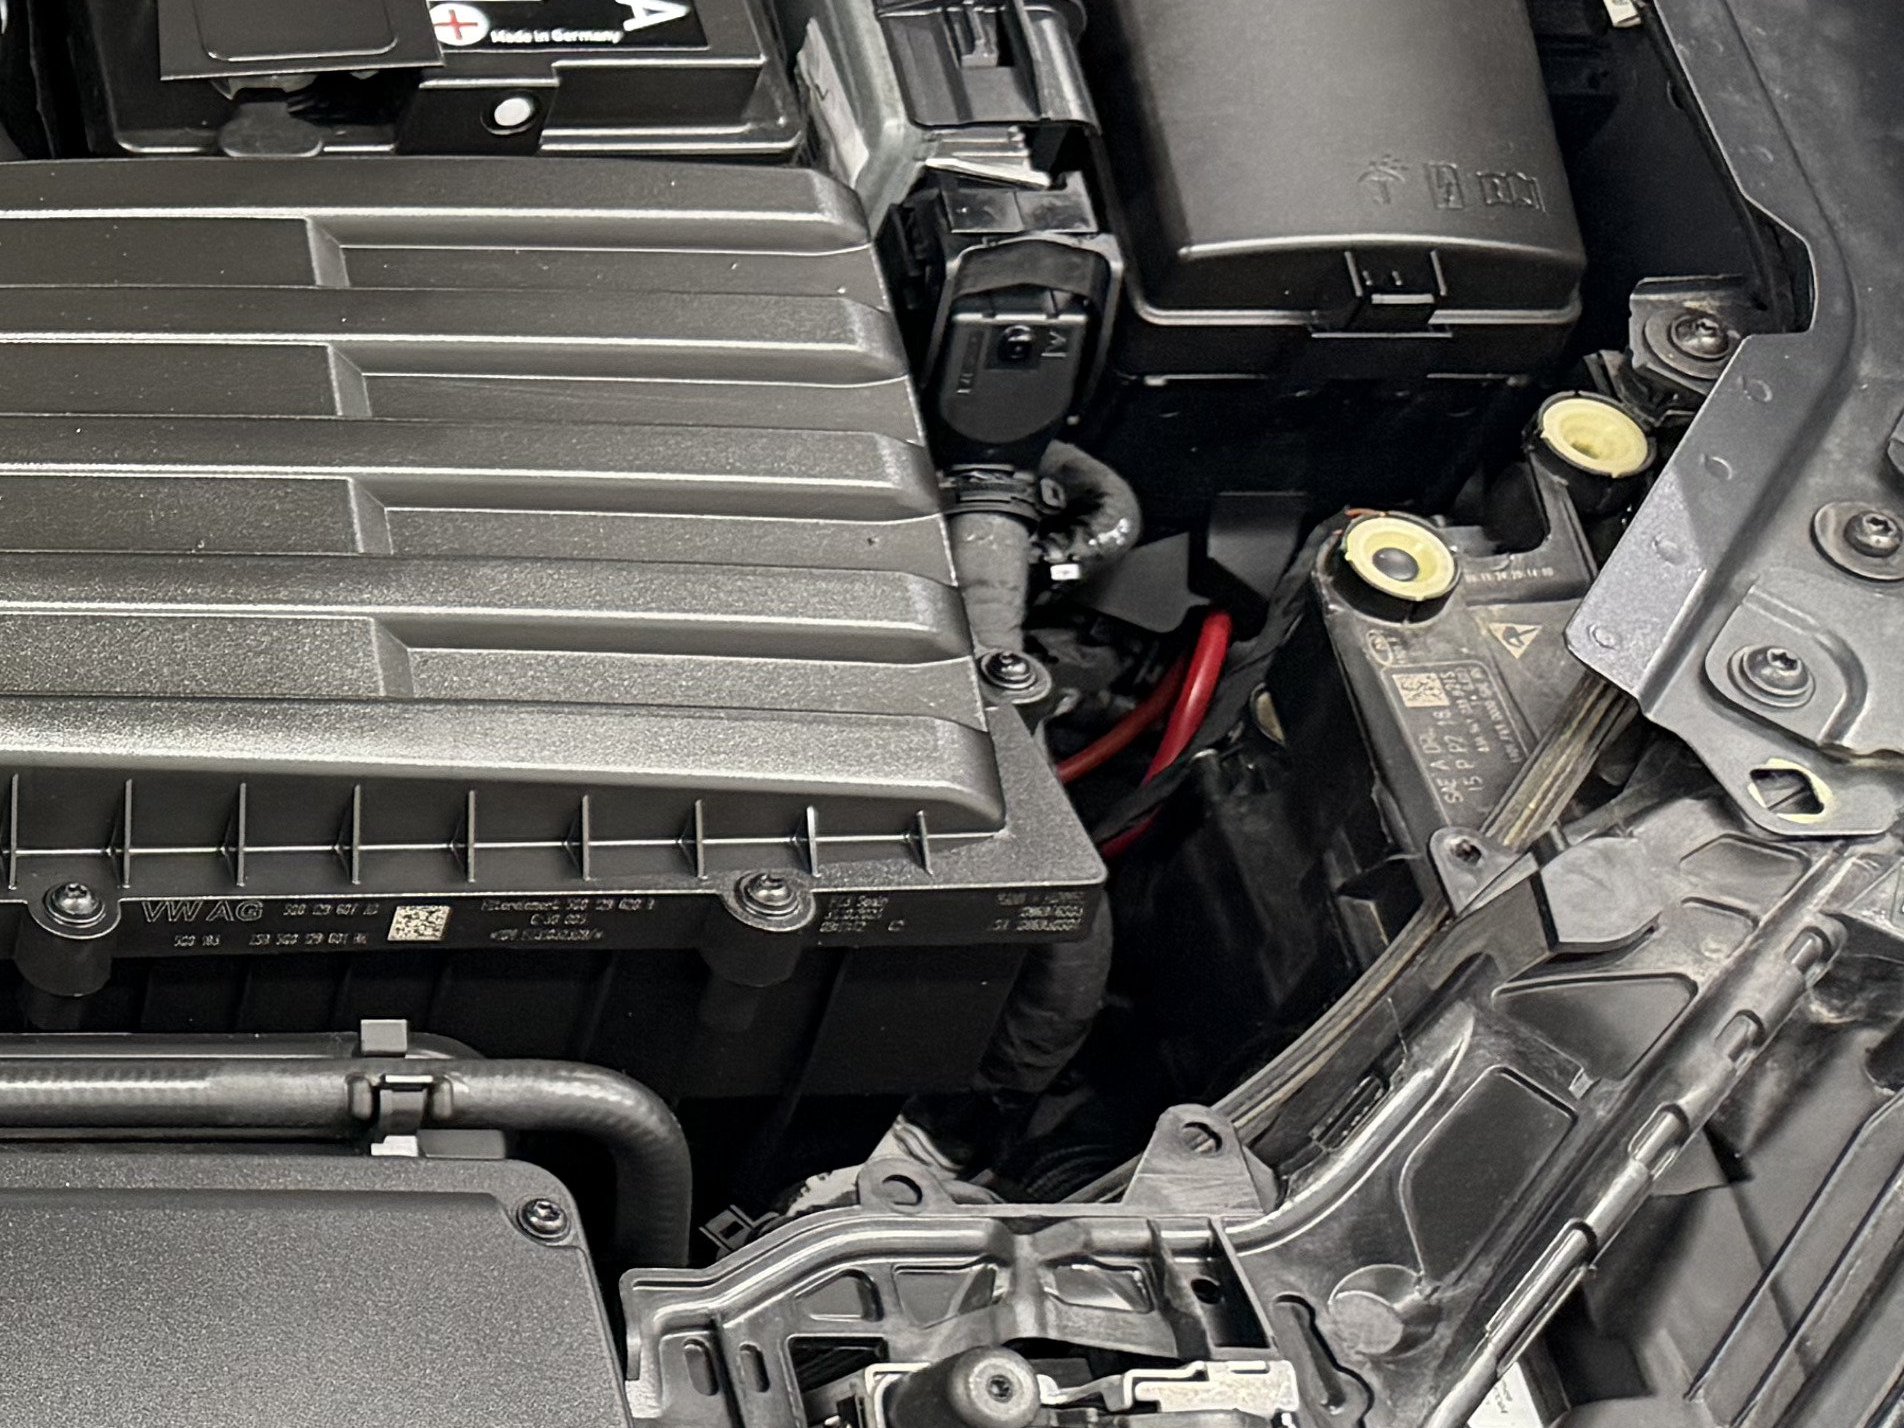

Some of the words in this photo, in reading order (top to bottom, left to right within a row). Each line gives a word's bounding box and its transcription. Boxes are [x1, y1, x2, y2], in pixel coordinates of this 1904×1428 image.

[490, 29, 533, 43] Made
[534, 30, 549, 43] in
[551, 28, 624, 44] Germany
[142, 903, 208, 922] VW
[209, 901, 263, 922] AG
